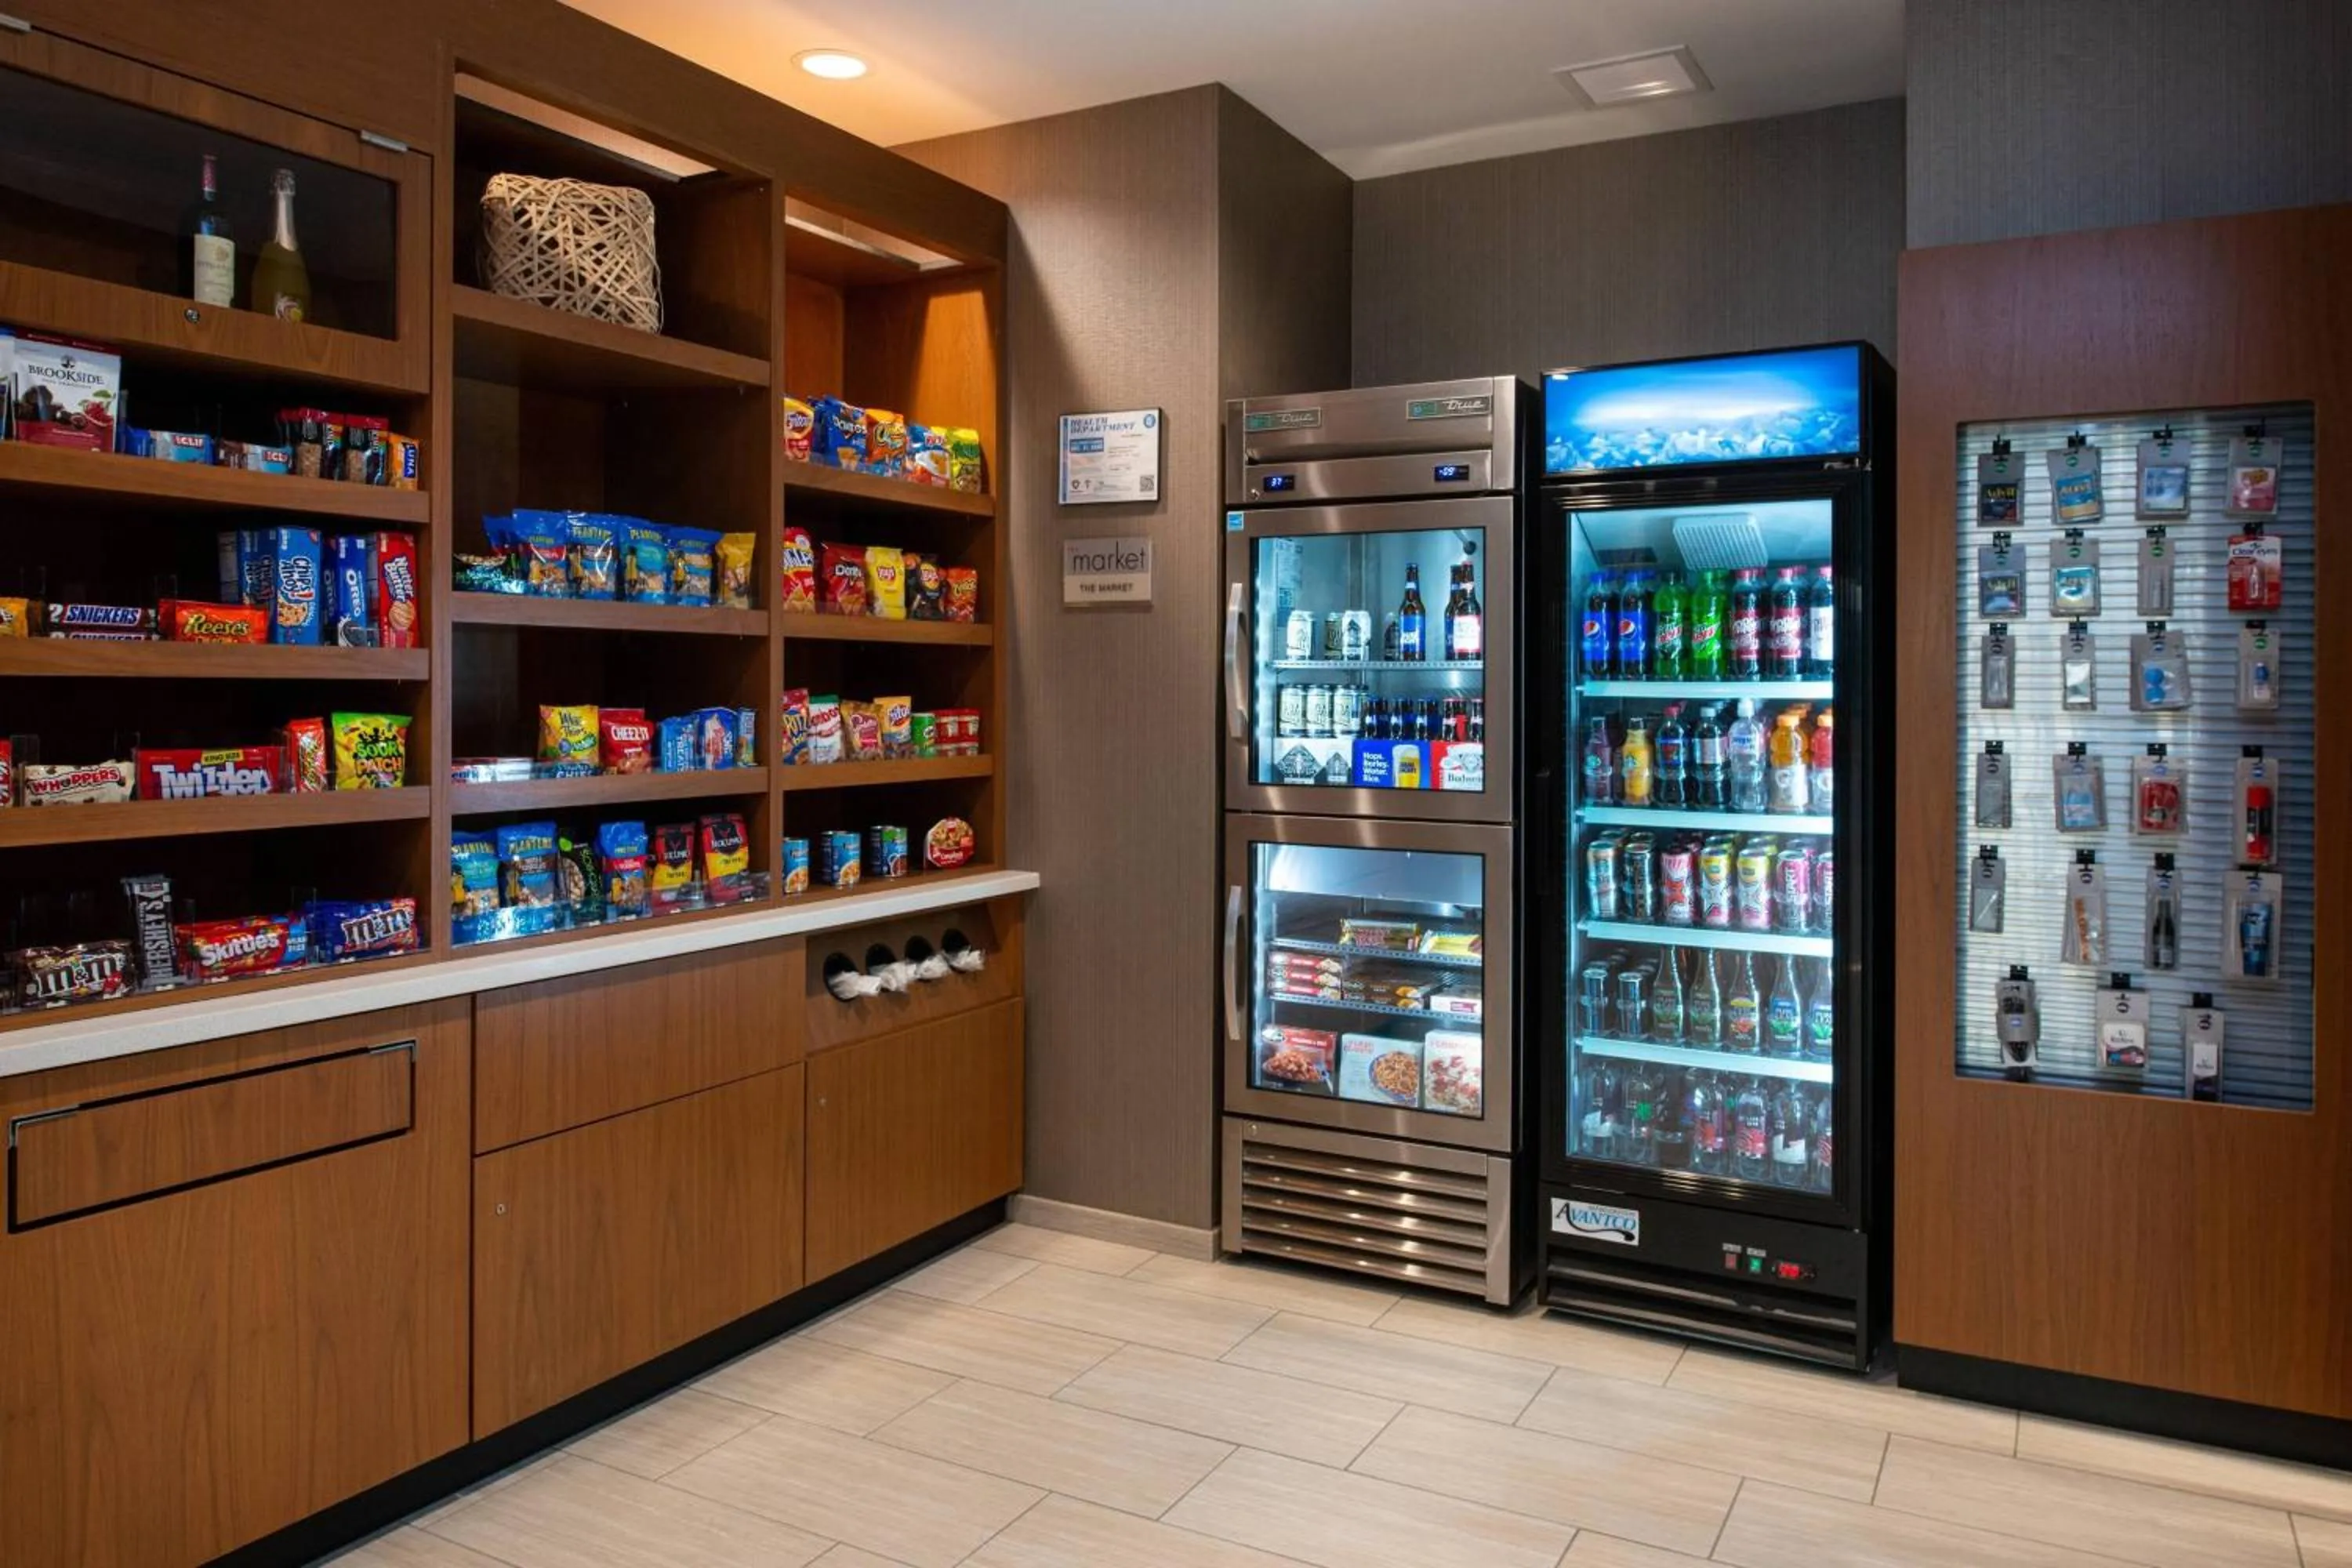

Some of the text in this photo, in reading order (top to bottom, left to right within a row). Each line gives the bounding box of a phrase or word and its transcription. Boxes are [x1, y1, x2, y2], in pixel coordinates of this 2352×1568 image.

[28, 364, 105, 386] BROOKSIDE
[833, 414, 866, 433] Doritos
[405, 444, 417, 477] LUNA
[1073, 541, 1146, 572] market
[1080, 583, 1134, 593] THE MARKET
[65, 605, 140, 625] SNICKERS
[356, 742, 399, 757] SOUR
[357, 757, 402, 772] PATCH
[31, 768, 119, 793] WHOPPERS
[142, 901, 173, 979] HERSHEY'S
[199, 931, 280, 967] Skittles
[1556, 1202, 1636, 1230] AVANTCO
